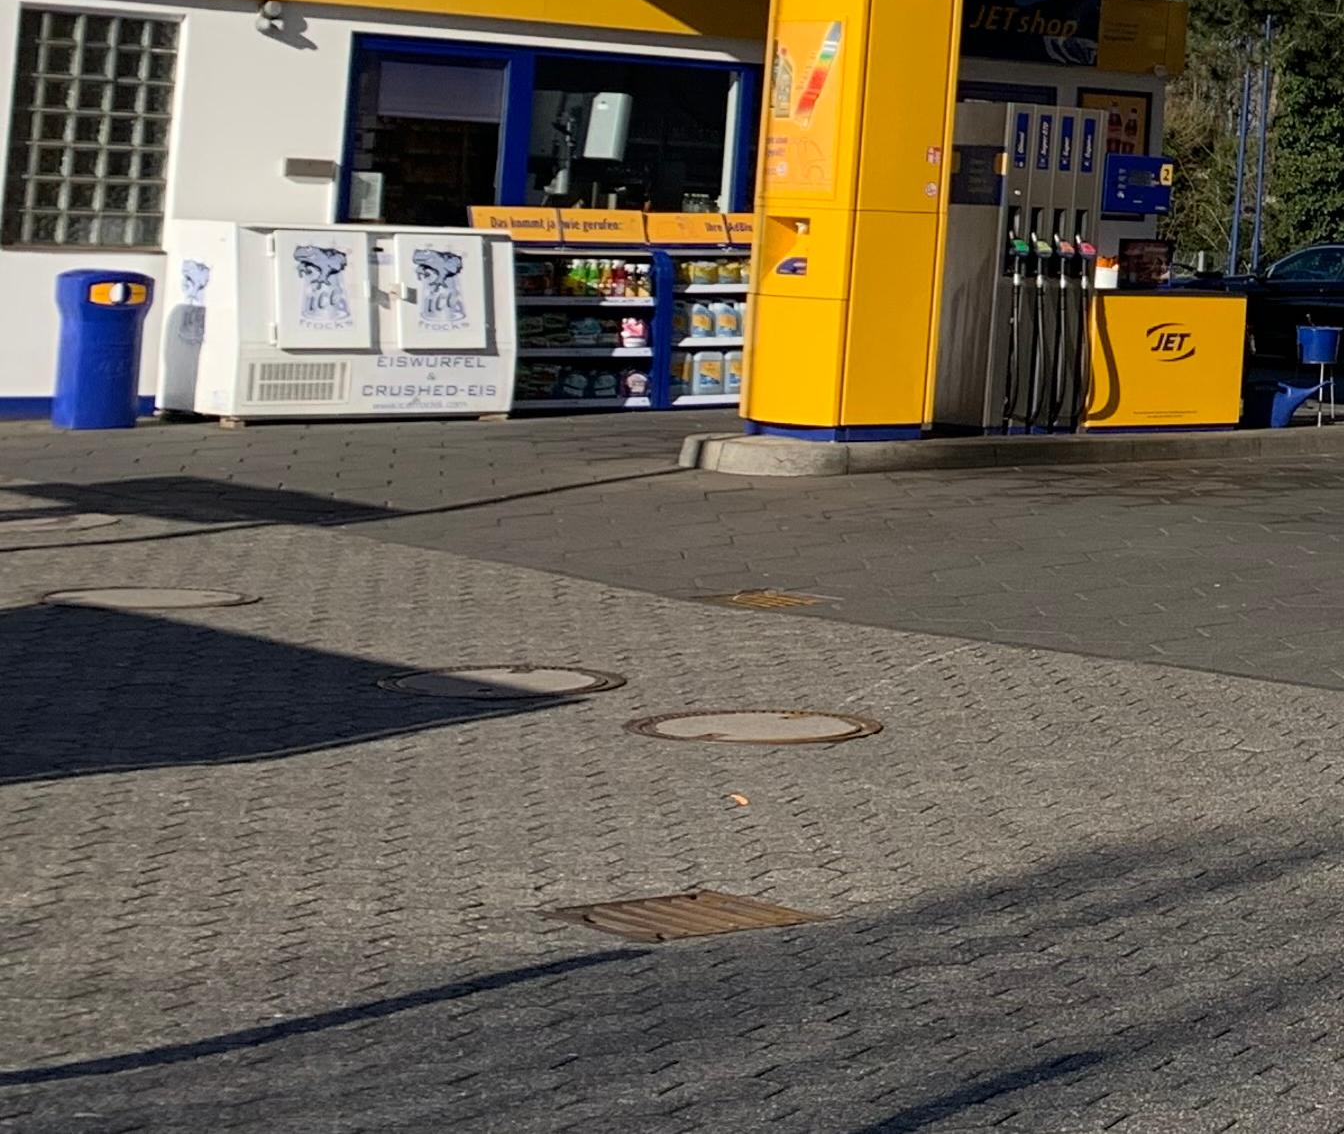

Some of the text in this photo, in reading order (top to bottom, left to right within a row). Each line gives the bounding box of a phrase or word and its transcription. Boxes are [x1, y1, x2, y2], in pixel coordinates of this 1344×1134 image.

[969, 4, 1018, 30] JET
[1018, 10, 1078, 38] shop
[1162, 169, 1169, 181] 2
[490, 217, 507, 228] Das
[510, 217, 544, 228] kommt
[547, 218, 556, 231] ja
[561, 220, 580, 230] wie
[1151, 332, 1192, 352] JET
[361, 384, 497, 397] CRUSHED-EIS
